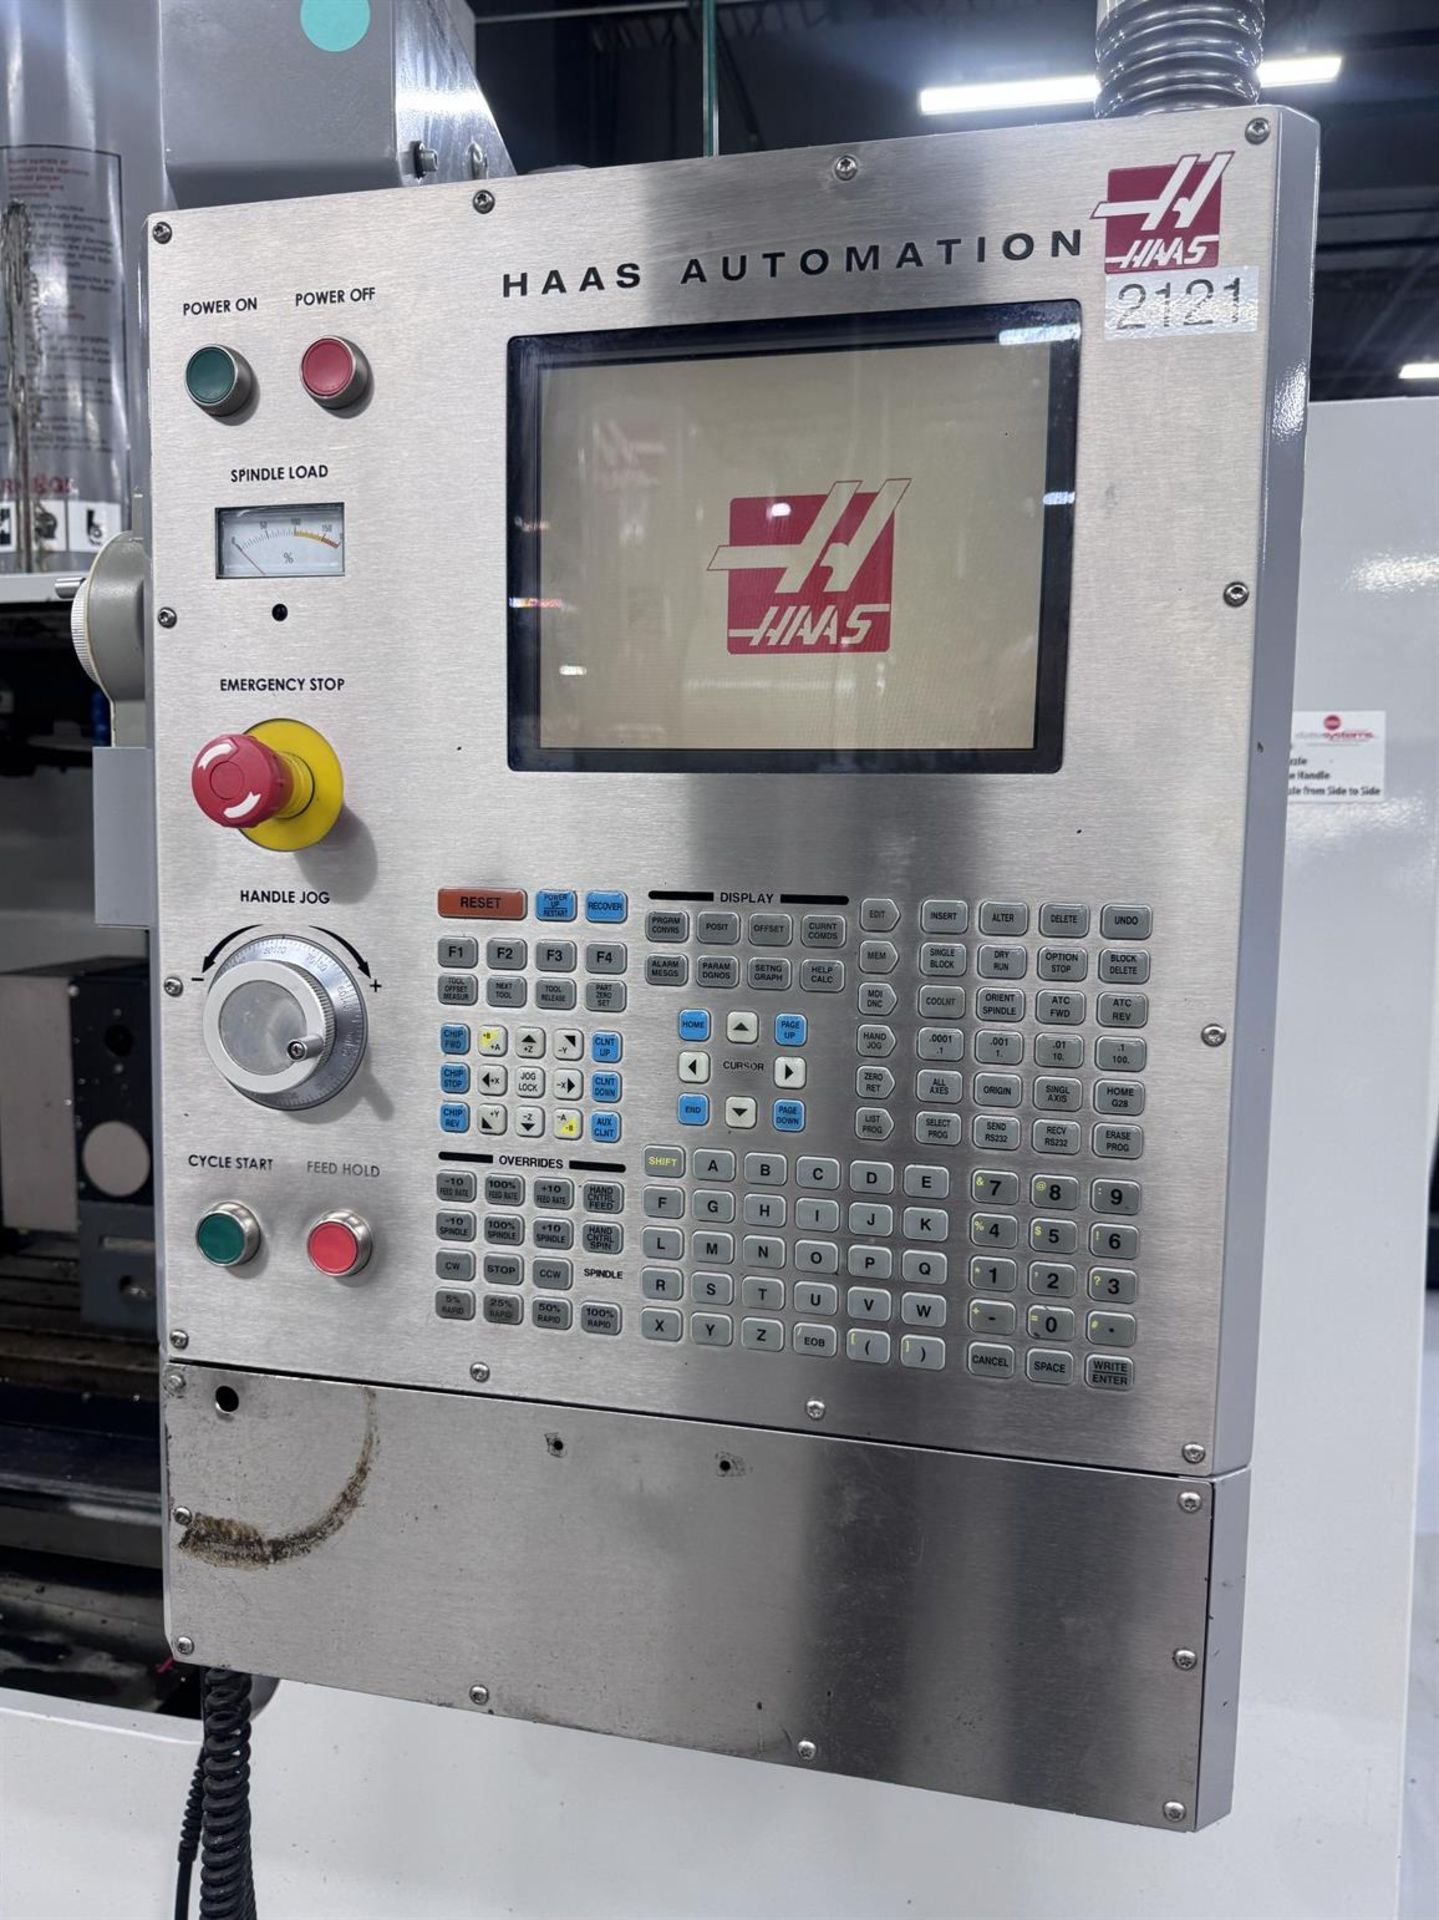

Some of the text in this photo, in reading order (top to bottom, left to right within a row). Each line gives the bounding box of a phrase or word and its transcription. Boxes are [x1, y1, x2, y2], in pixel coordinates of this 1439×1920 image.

[1105, 234, 1218, 268] HAAS
[501, 229, 1082, 299] HAAS AUTOMATION
[295, 288, 375, 306] POWER OFF
[183, 298, 257, 316] POWER ON
[1117, 278, 1241, 330] 2121
[231, 465, 328, 482] SPINDLE LOAD
[729, 603, 890, 646] HAAS
[220, 678, 345, 691] EMERGENCY STOP
[1328, 787, 1346, 795] Side
[1360, 787, 1380, 795] Side
[240, 890, 330, 904] HANDLE JOG
[720, 893, 774, 903] DISPLAY
[460, 897, 502, 909] RESET
[588, 902, 622, 911] RECOVER
[930, 912, 957, 920] INSERT
[992, 914, 1014, 922] ALTER
[1051, 915, 1077, 923] DELETE
[1115, 916, 1138, 925] UNDO
[706, 923, 728, 931] POSIT
[754, 925, 783, 933] OFFSET
[449, 946, 463, 957] F1
[497, 948, 513, 959] F2
[546, 950, 562, 961] F3
[867, 952, 886, 960] MEM
[930, 948, 955, 956] SINGLE
[994, 951, 1009, 959] DRY
[1045, 953, 1078, 961] OPTION
[596, 952, 612, 963] F4
[1110, 954, 1136, 962] BLOCK
[930, 960, 954, 968] BLOCK
[1052, 965, 1071, 973] STOP
[812, 966, 832, 974] HELP
[1110, 966, 1137, 975] DELETE
[811, 975, 833, 983] CALC
[496, 991, 512, 999] TOOL
[985, 994, 1015, 1002] ORIENT
[926, 997, 955, 1005] COOLNT
[1113, 999, 1131, 1007] ATC
[983, 1006, 1016, 1015] SPINDLE
[1050, 1009, 1070, 1017] FWD
[1112, 1012, 1131, 1021] REV
[682, 1021, 705, 1029] HOME
[781, 1021, 799, 1029] PAGE
[864, 1032, 886, 1040] HAND
[600, 1049, 611, 1057] UP
[723, 1061, 764, 1071] CURSOR
[520, 1072, 535, 1080] JOG
[519, 1084, 537, 1092] LOCK
[595, 1088, 615, 1097] DOWN
[866, 1084, 880, 1092] RET
[930, 1086, 949, 1094] AXES
[983, 1086, 1011, 1095] ORIGIN
[1107, 1087, 1134, 1095] HOME
[779, 1106, 797, 1114] PAGE
[445, 1119, 460, 1127] REV
[776, 1117, 799, 1125] DOWN
[987, 1122, 1006, 1130] SEND
[594, 1128, 614, 1137] CLNT
[1106, 1131, 1131, 1140] ERASE
[985, 1134, 1007, 1143] RS232
[188, 1155, 273, 1170] CYCLE START
[499, 1156, 563, 1169] OVERRIDES
[648, 1156, 677, 1166] SHIFT
[708, 1160, 718, 1172] A
[307, 1161, 380, 1178] FEED HOLD
[760, 1164, 770, 1176] B
[812, 1168, 823, 1180] C
[866, 1172, 877, 1184] D
[922, 1176, 932, 1188] E
[989, 1180, 1001, 1195] 7
[1049, 1185, 1061, 1201] 8
[1111, 1189, 1123, 1205] 9
[589, 1202, 613, 1210] FEED
[658, 1198, 666, 1208] F
[708, 1201, 718, 1213] G
[760, 1205, 770, 1216] H
[816, 1210, 819, 1222] I
[867, 1214, 876, 1226] J
[921, 1218, 932, 1230] K
[989, 1223, 1000, 1238] 4
[1049, 1229, 1059, 1243] 5
[657, 1238, 665, 1249] L
[1109, 1234, 1120, 1249] 6
[706, 1243, 718, 1255] M
[758, 1246, 768, 1258] N
[811, 1252, 822, 1264] O
[866, 1256, 875, 1268] P
[445, 1262, 460, 1270] CW
[487, 1265, 516, 1274] STOP
[919, 1262, 930, 1275] Q
[540, 1270, 561, 1278] CCW
[584, 1269, 622, 1279] SPINDLE
[989, 1268, 997, 1283] 1
[656, 1280, 666, 1290] R
[1047, 1273, 1059, 1289] 2
[1108, 1279, 1120, 1294] 3
[706, 1284, 716, 1295] S
[758, 1288, 767, 1300] T
[810, 1294, 820, 1306] U
[864, 1299, 874, 1311] V
[916, 1304, 931, 1317] W
[655, 1320, 664, 1332] X
[706, 1324, 715, 1336] Y
[1046, 1317, 1057, 1333] 0
[757, 1329, 766, 1341] Z
[804, 1336, 824, 1346] EOB
[972, 1355, 1009, 1367] CANCEL
[1093, 1361, 1127, 1372] WRITE
[1034, 1361, 1065, 1373] SPACE
[1092, 1374, 1127, 1385] ENTER
